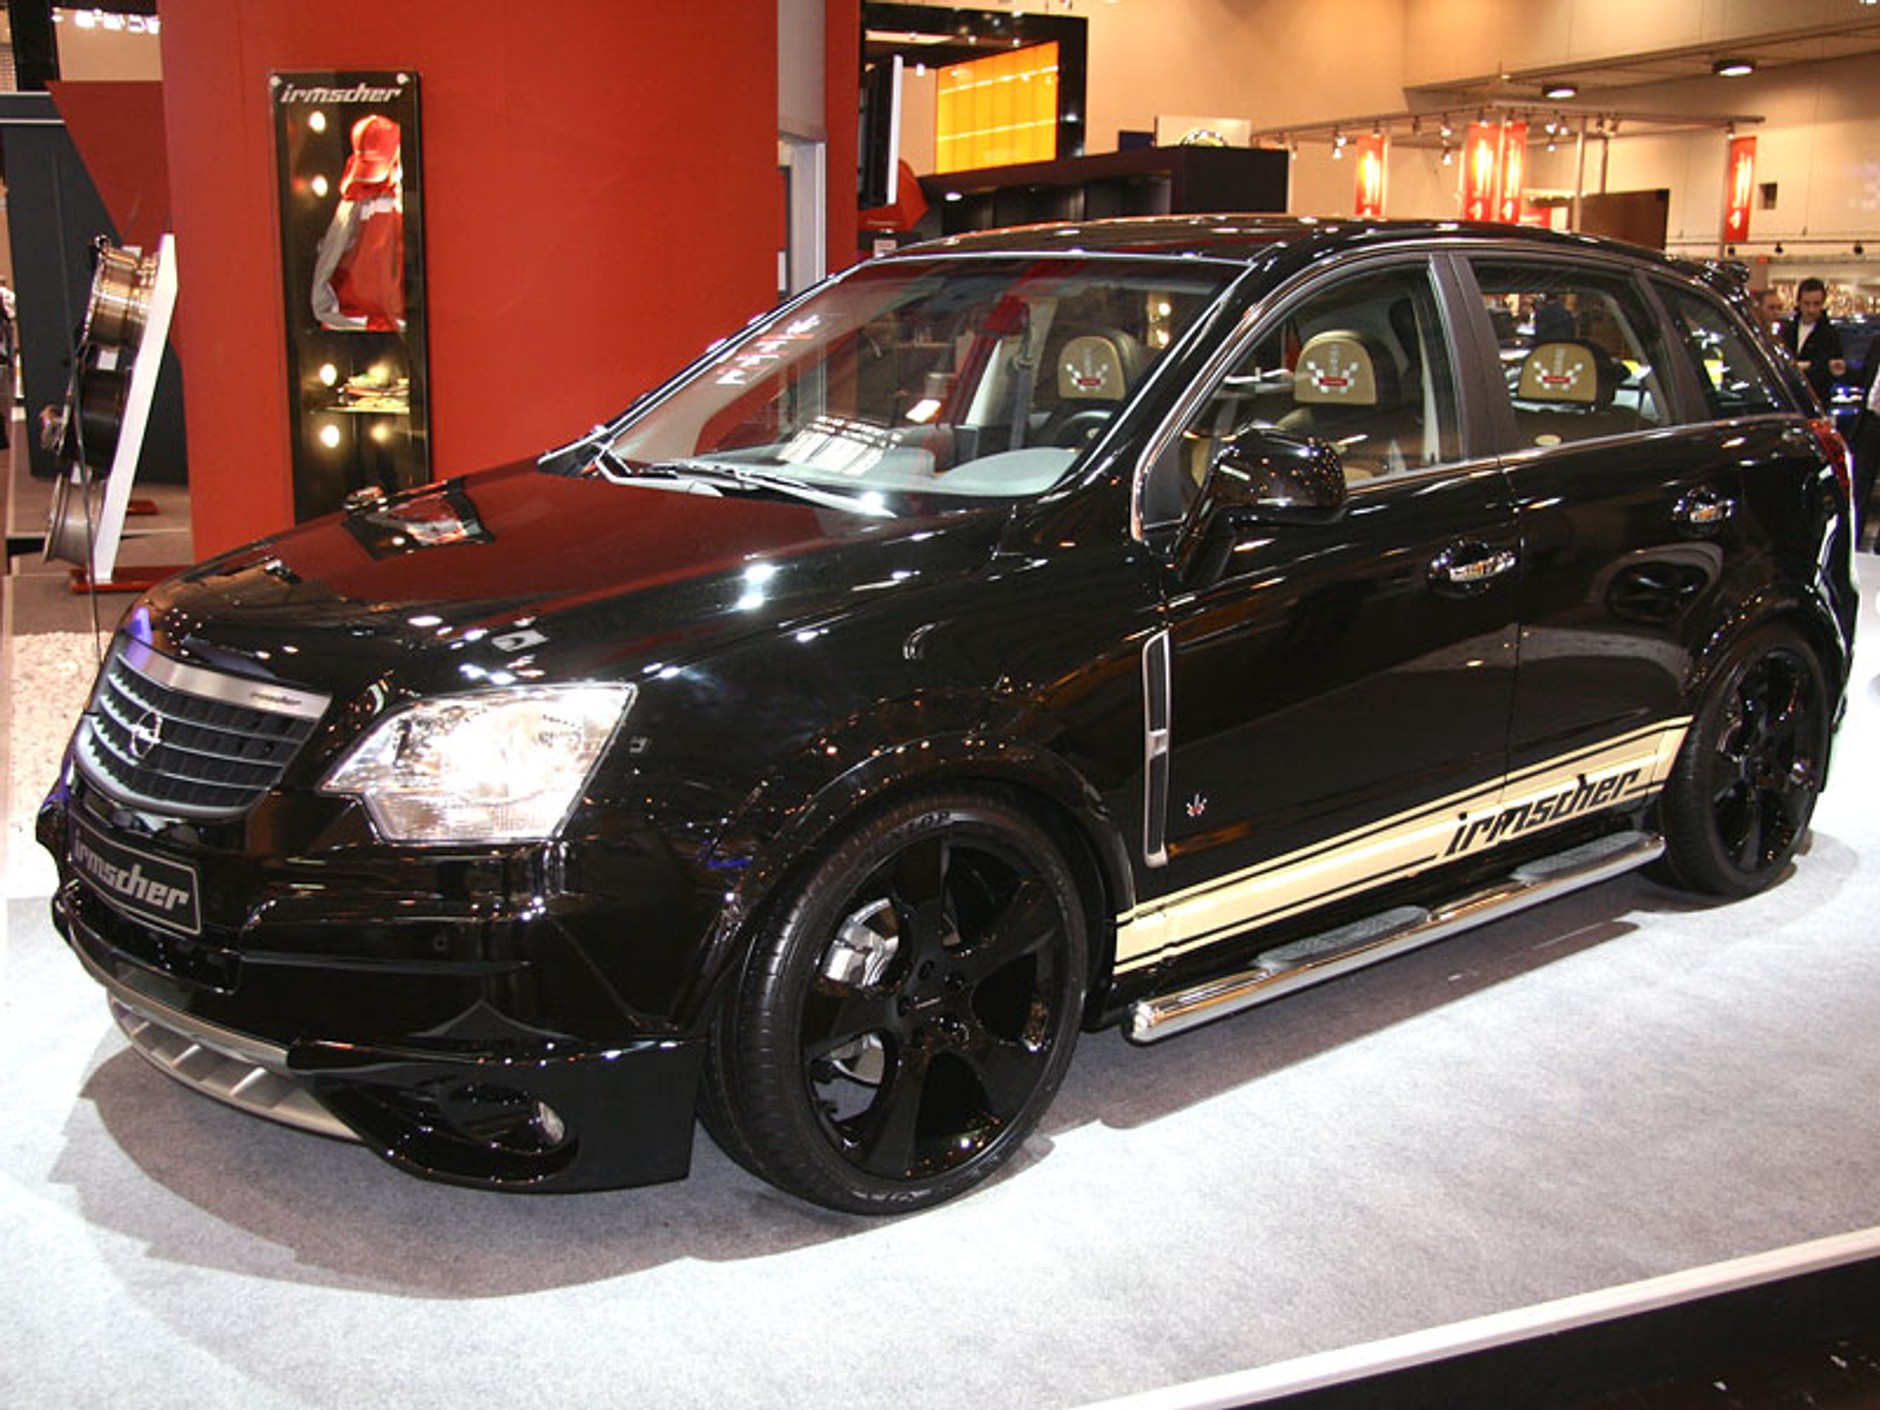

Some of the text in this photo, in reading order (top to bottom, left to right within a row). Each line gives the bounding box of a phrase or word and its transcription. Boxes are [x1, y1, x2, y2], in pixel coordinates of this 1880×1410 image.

[280, 83, 402, 103] irmscher
[1445, 768, 1641, 856] irmscher
[75, 829, 190, 910] irmscher
